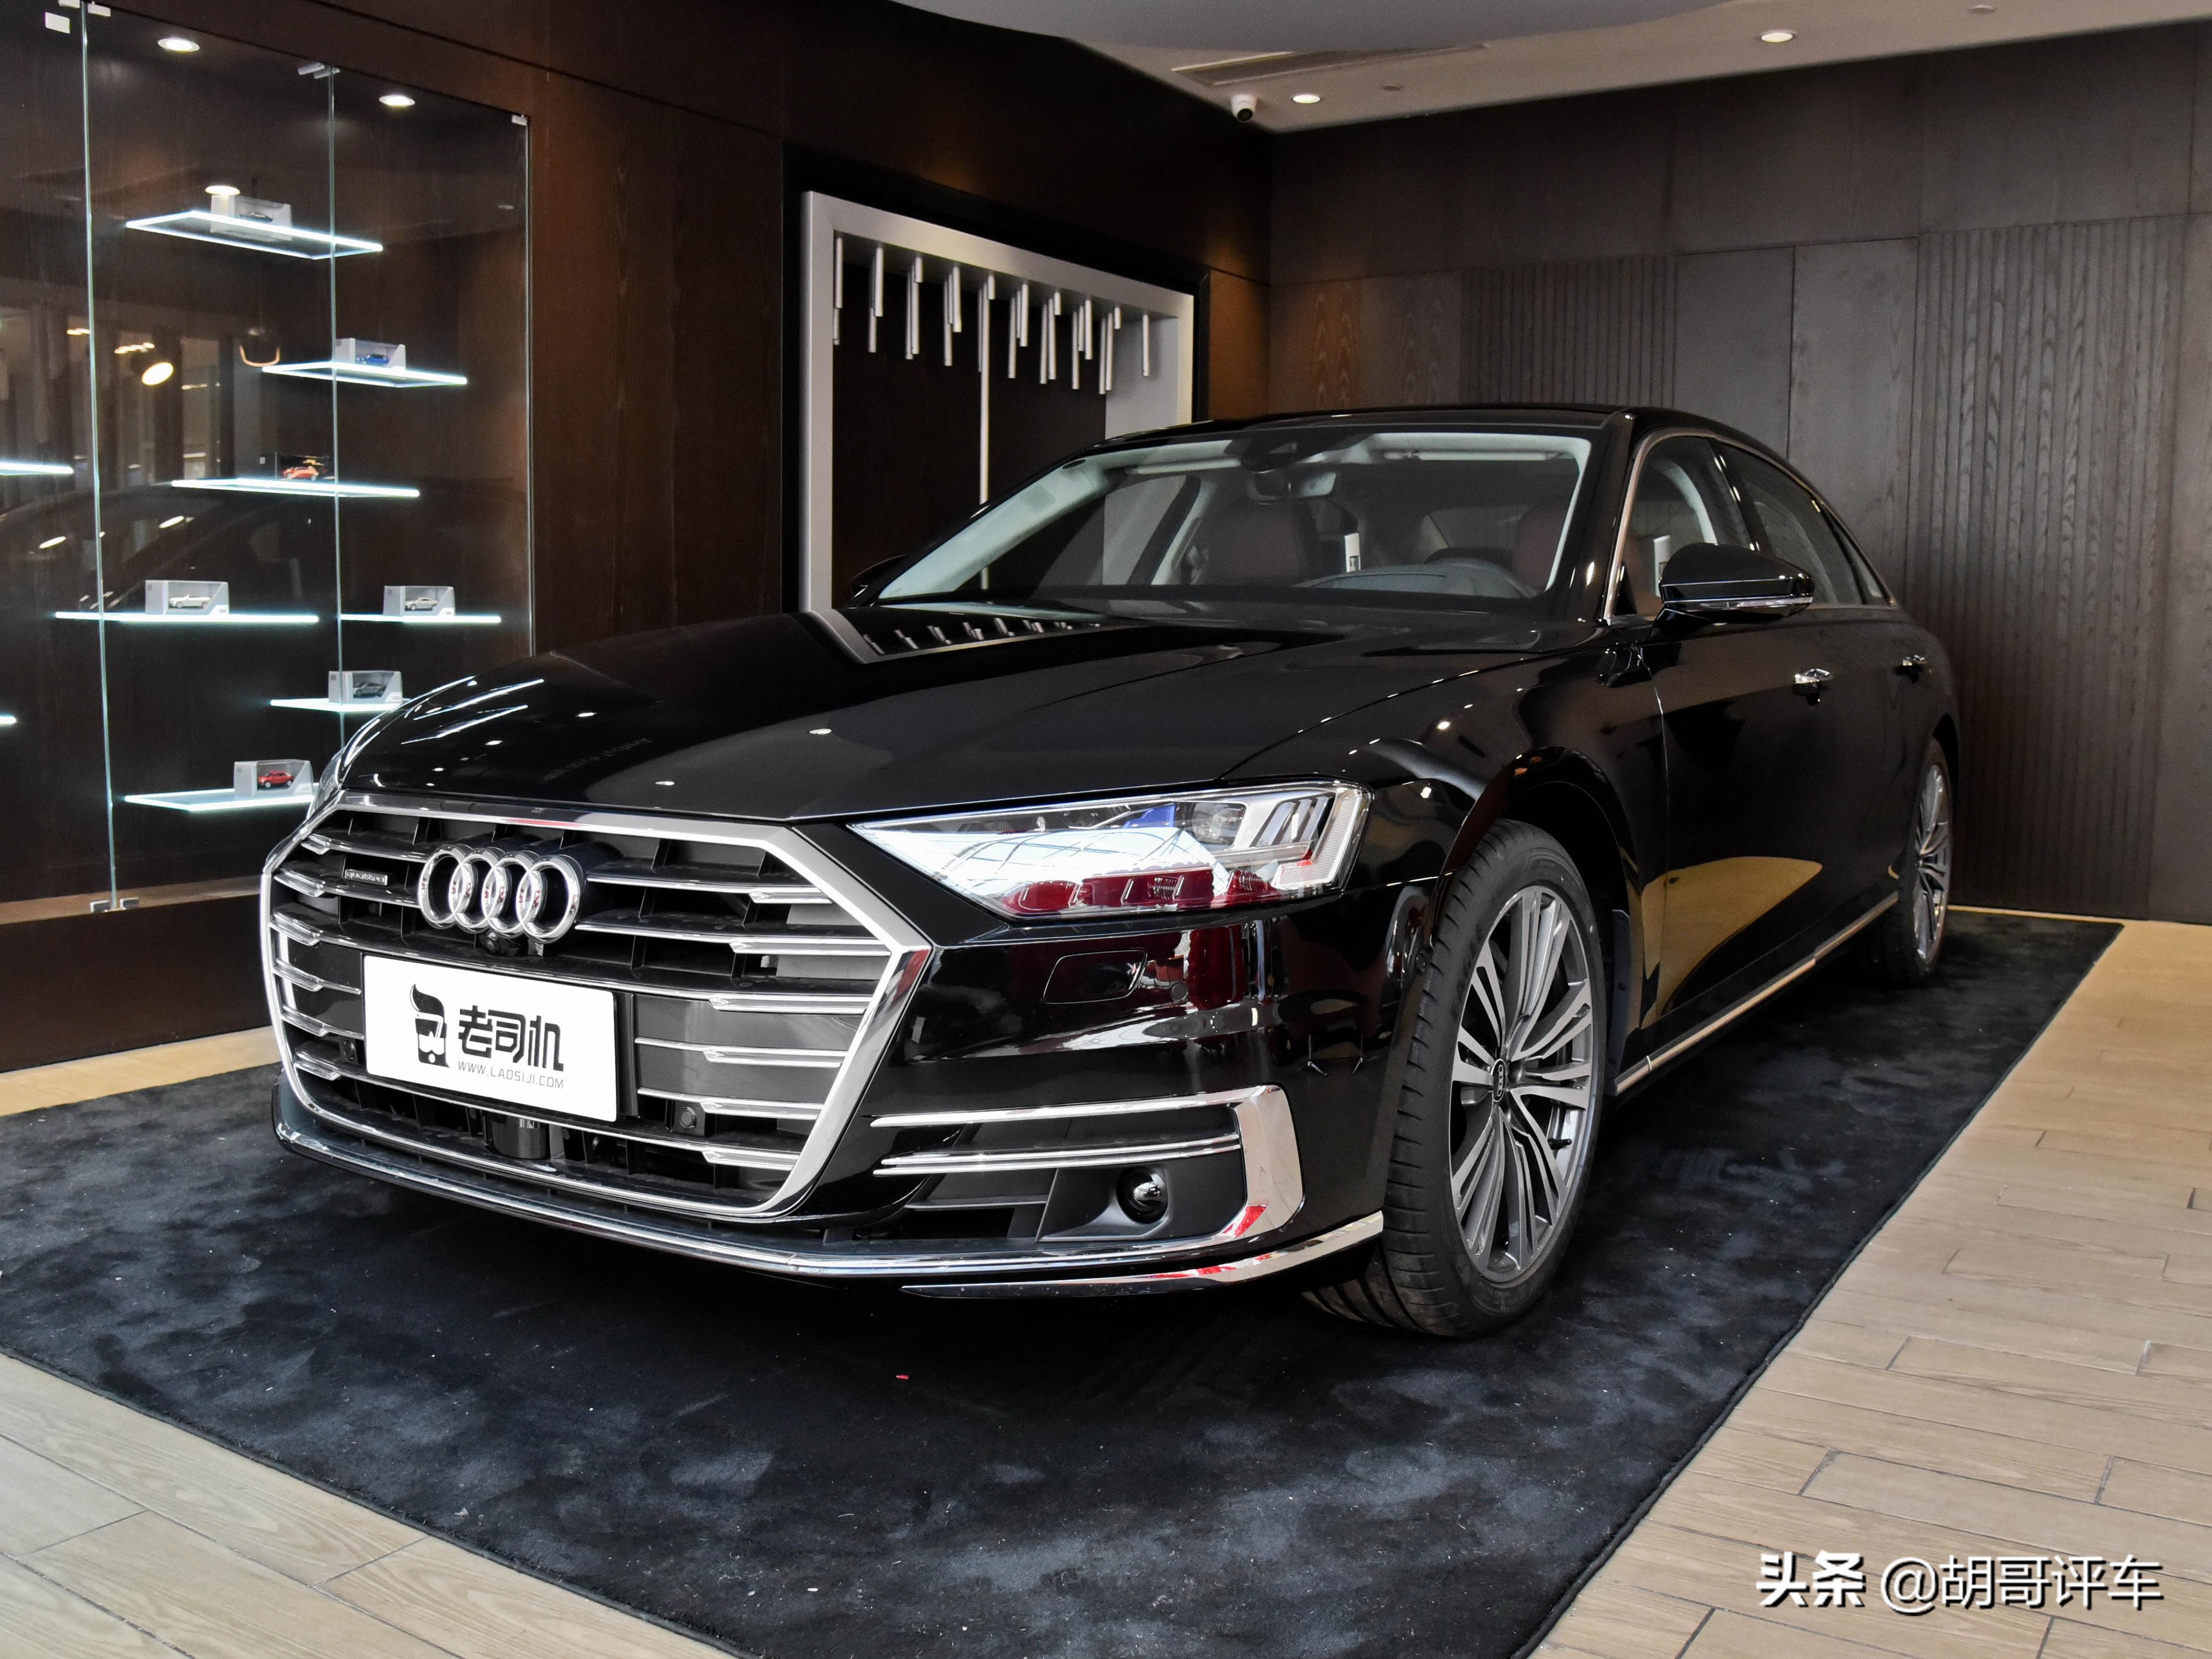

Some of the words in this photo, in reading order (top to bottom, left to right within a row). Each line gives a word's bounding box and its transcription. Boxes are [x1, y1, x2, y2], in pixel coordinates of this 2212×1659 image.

[458, 1005, 564, 1072] 老司机
[458, 1061, 564, 1089] WWW.LAOSIJI.COM
